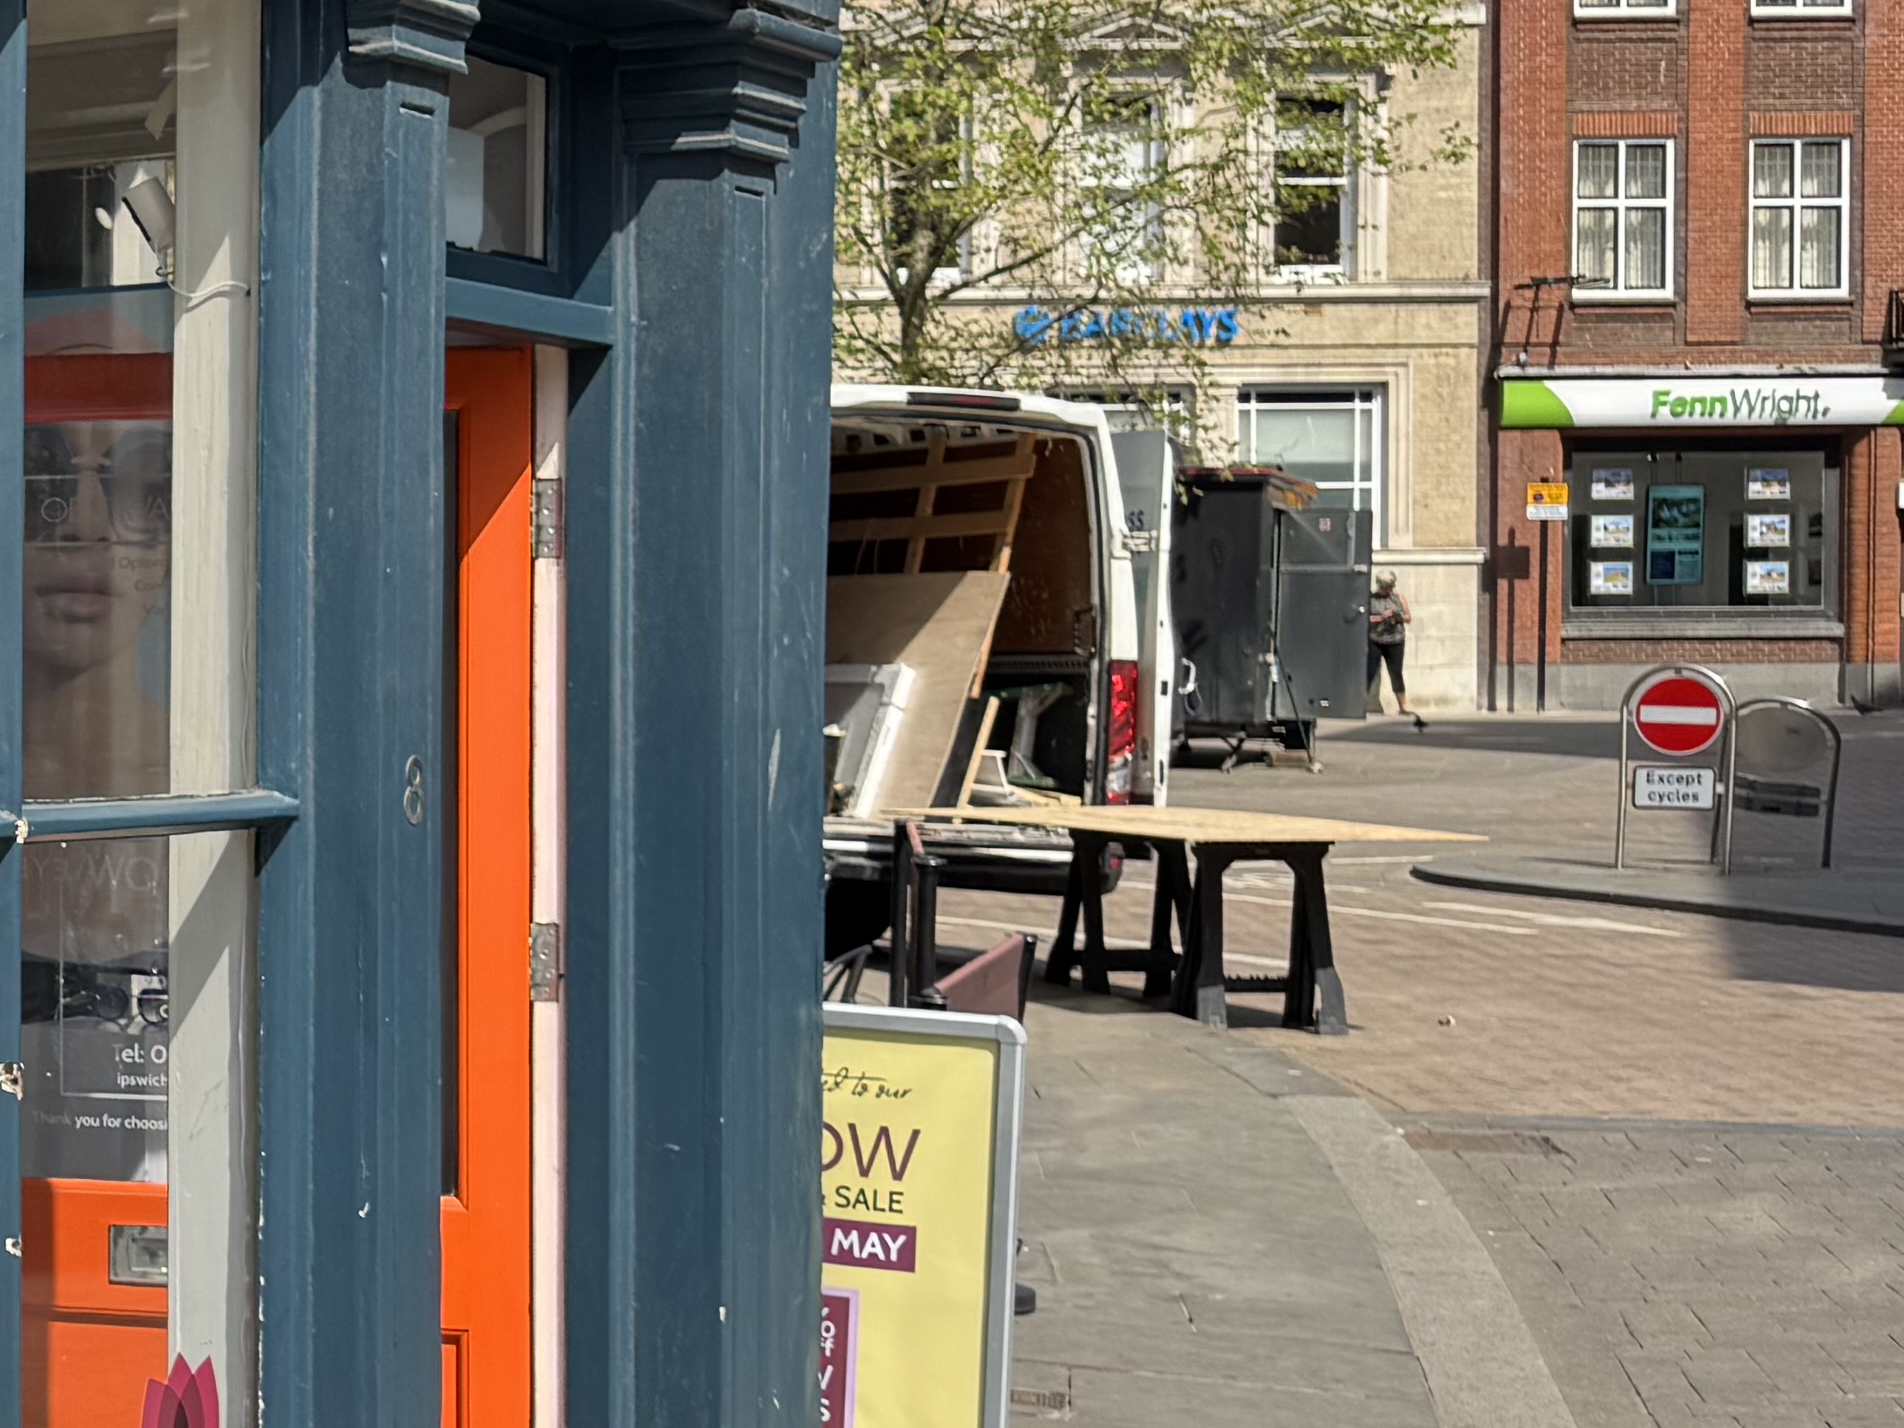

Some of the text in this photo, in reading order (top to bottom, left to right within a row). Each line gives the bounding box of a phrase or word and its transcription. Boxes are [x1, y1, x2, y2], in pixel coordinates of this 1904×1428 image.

[403, 754, 424, 825] 8
[1646, 771, 1703, 787] Except
[1647, 788, 1700, 804] cycles
[74, 1115, 100, 1130] you
[102, 1112, 122, 1129] for
[123, 1115, 168, 1132] choosi
[834, 1184, 905, 1215] SALE
[830, 1227, 908, 1263] MAY
